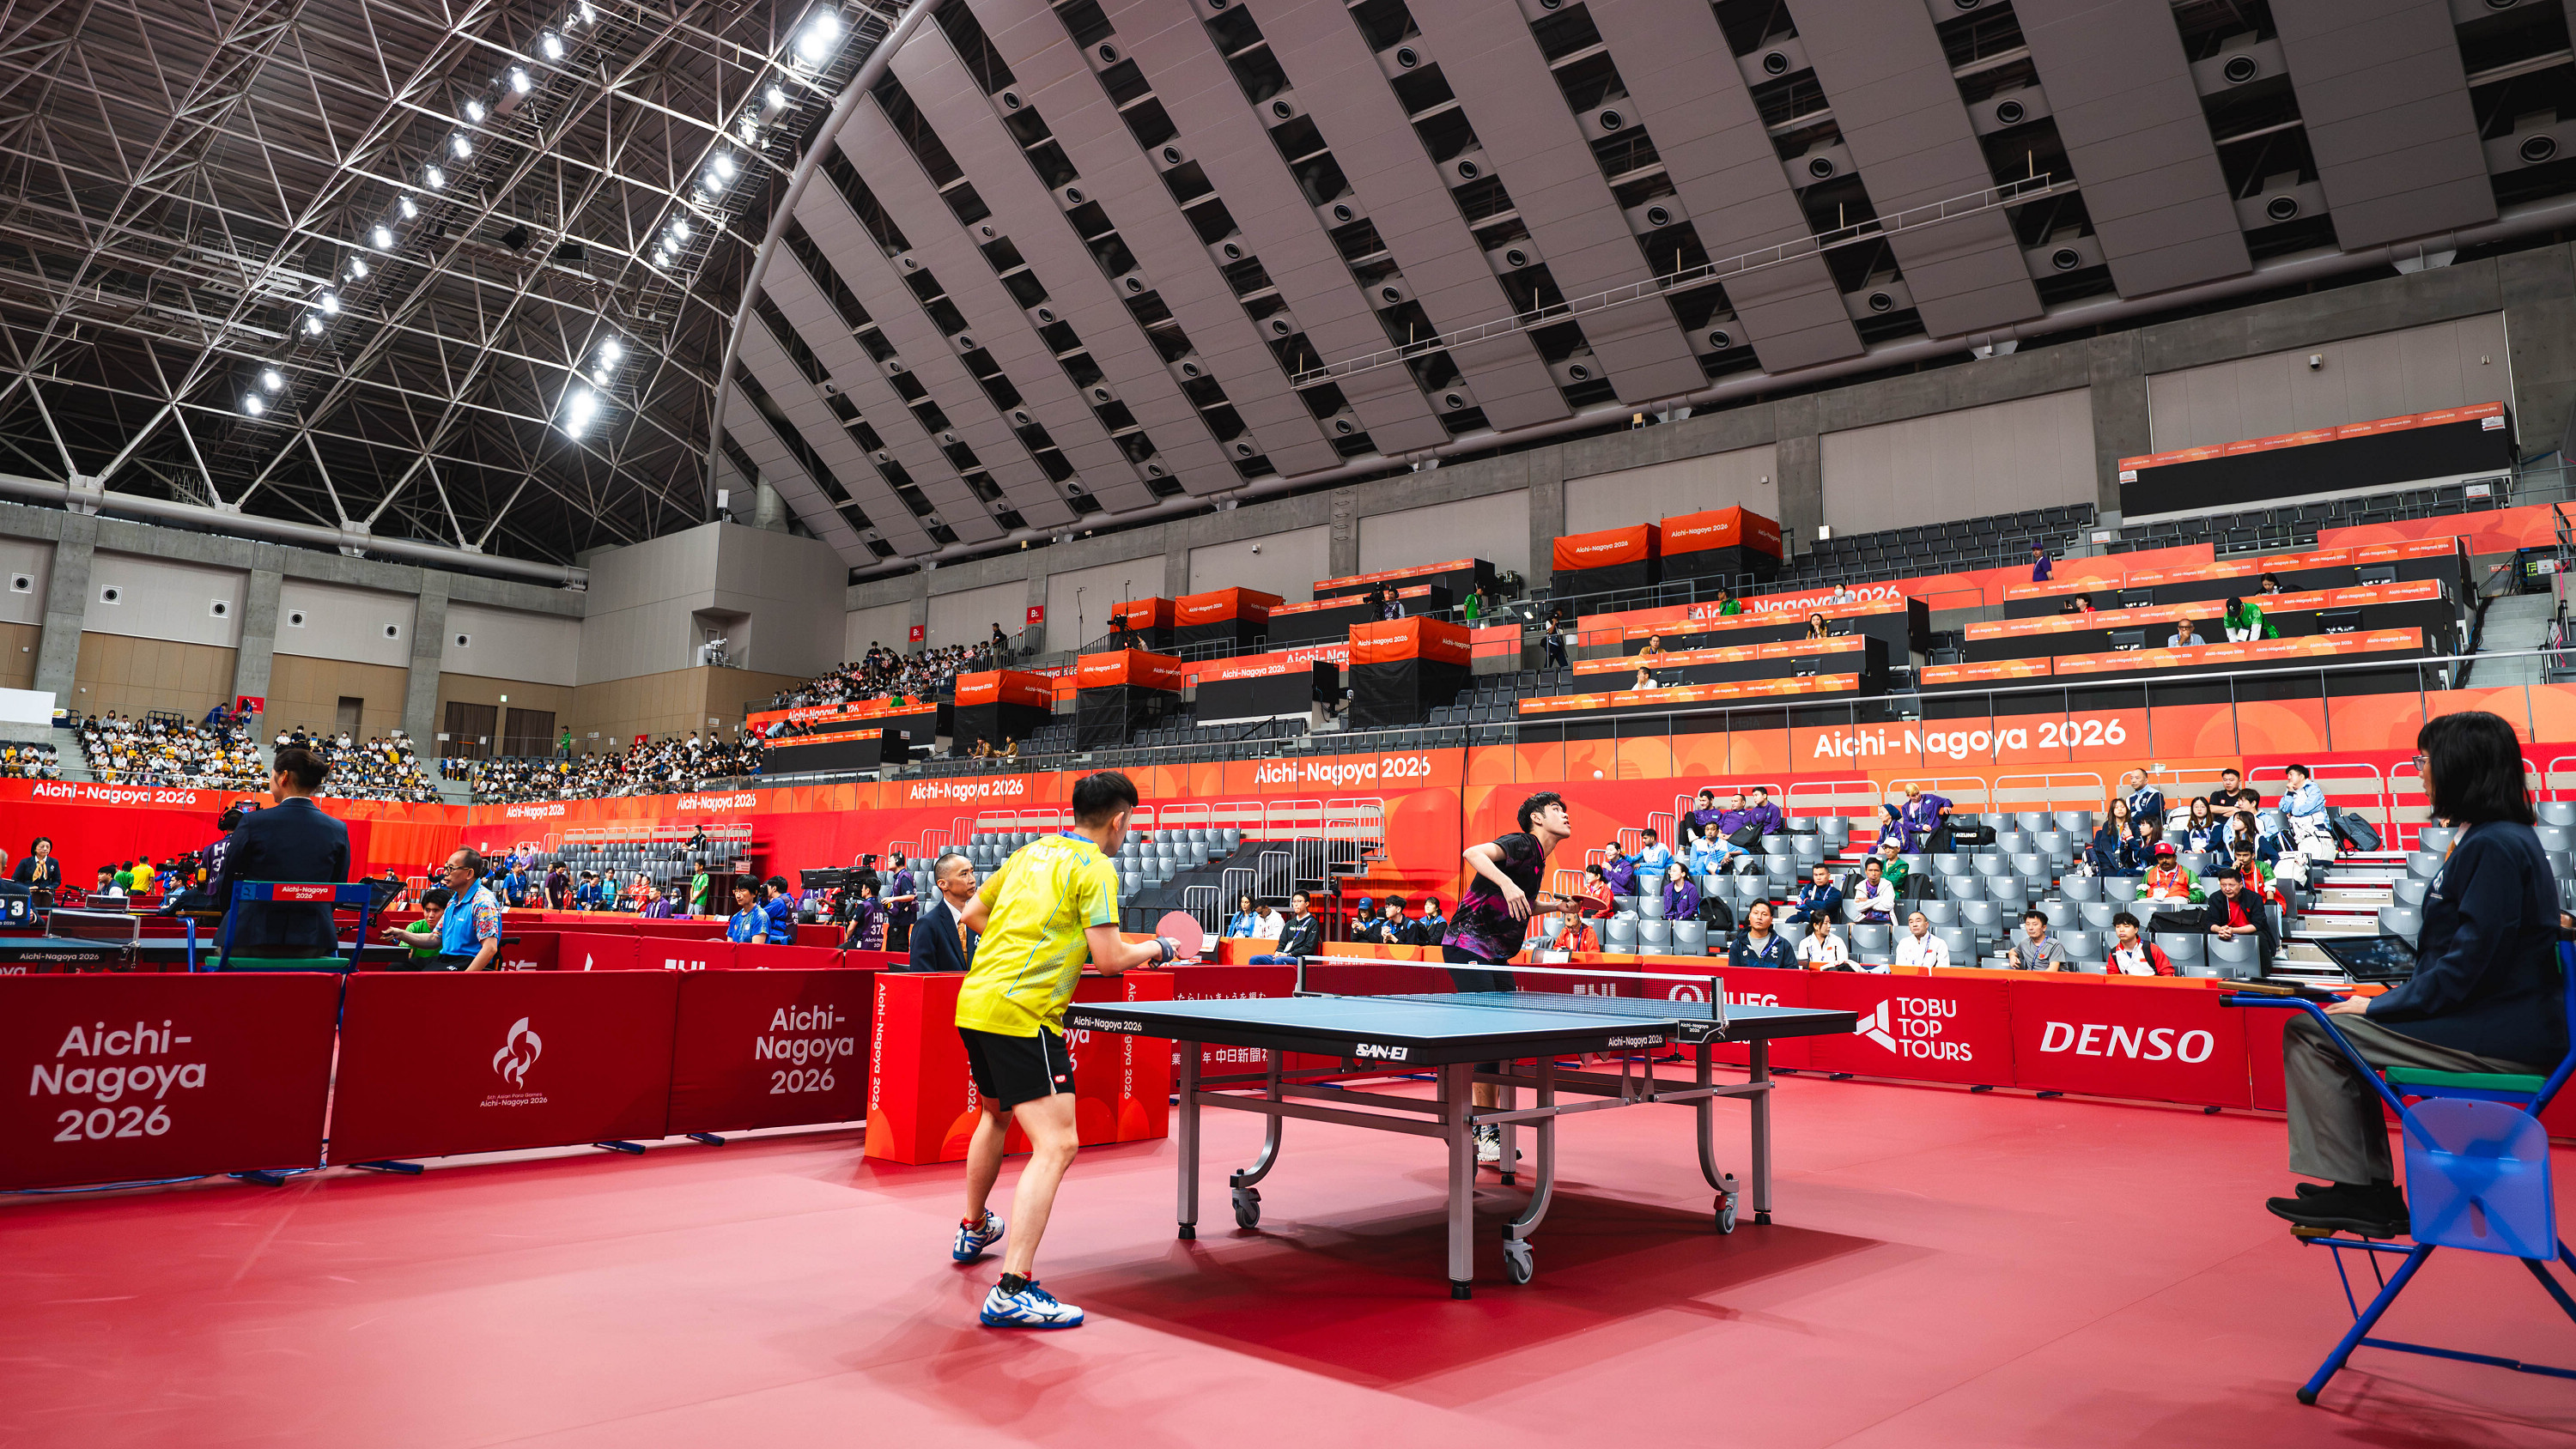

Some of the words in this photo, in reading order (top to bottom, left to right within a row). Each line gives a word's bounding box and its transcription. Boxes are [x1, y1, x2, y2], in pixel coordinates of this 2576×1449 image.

[1671, 526, 1712, 537] Aichi-Nagoya
[1576, 543, 1613, 553] Aichi-Nagoya
[1358, 638, 1394, 646] Aichi-Nagoya
[1222, 667, 1267, 679] Aichi-Nagoya
[1268, 664, 1285, 674] 2026
[1814, 729, 2028, 761] Aichi-Nagoya
[2038, 719, 2127, 749] 2026
[1254, 761, 1376, 785] Aichi-Nagoya
[1382, 756, 1431, 779] 2026
[33, 783, 151, 805] Aichi-Nagoya
[155, 790, 197, 805] 2026
[677, 794, 733, 812] Aichi-Nagoya
[734, 793, 756, 808] 2026
[910, 781, 989, 803] Aichi-Nagoya
[993, 779, 1024, 797] 2026
[507, 805, 548, 821] Aichi-Nagoya
[549, 803, 565, 816] 2026
[11, 900, 24, 917] 3
[19, 953, 77, 961] Aichi-Nagoya
[769, 1004, 846, 1031] Aichi-
[1897, 997, 1957, 1017] TOBU
[873, 982, 886, 1074] Aichi-Nagoya
[1073, 1016, 1123, 1032] Aichi-Nagoya
[1123, 1022, 1142, 1032] 2026
[1897, 1019, 1942, 1034] TOP
[57, 1020, 192, 1058] Aichi-
[756, 1036, 854, 1065] Nagoya
[1607, 1035, 1648, 1047] Aichi-Nagoya
[1649, 1034, 1663, 1044] 2026
[1899, 1039, 1972, 1062] TOURS
[2039, 1022, 2215, 1064] DENSO
[30, 1063, 207, 1102] Nagoya
[769, 1068, 835, 1094] 2026
[1124, 1069, 1133, 1100] 2026
[479, 1098, 529, 1107] Aichi-Nagoya
[872, 1076, 881, 1111] 2026
[967, 1079, 977, 1113] 2026
[53, 1105, 172, 1143] 2026
